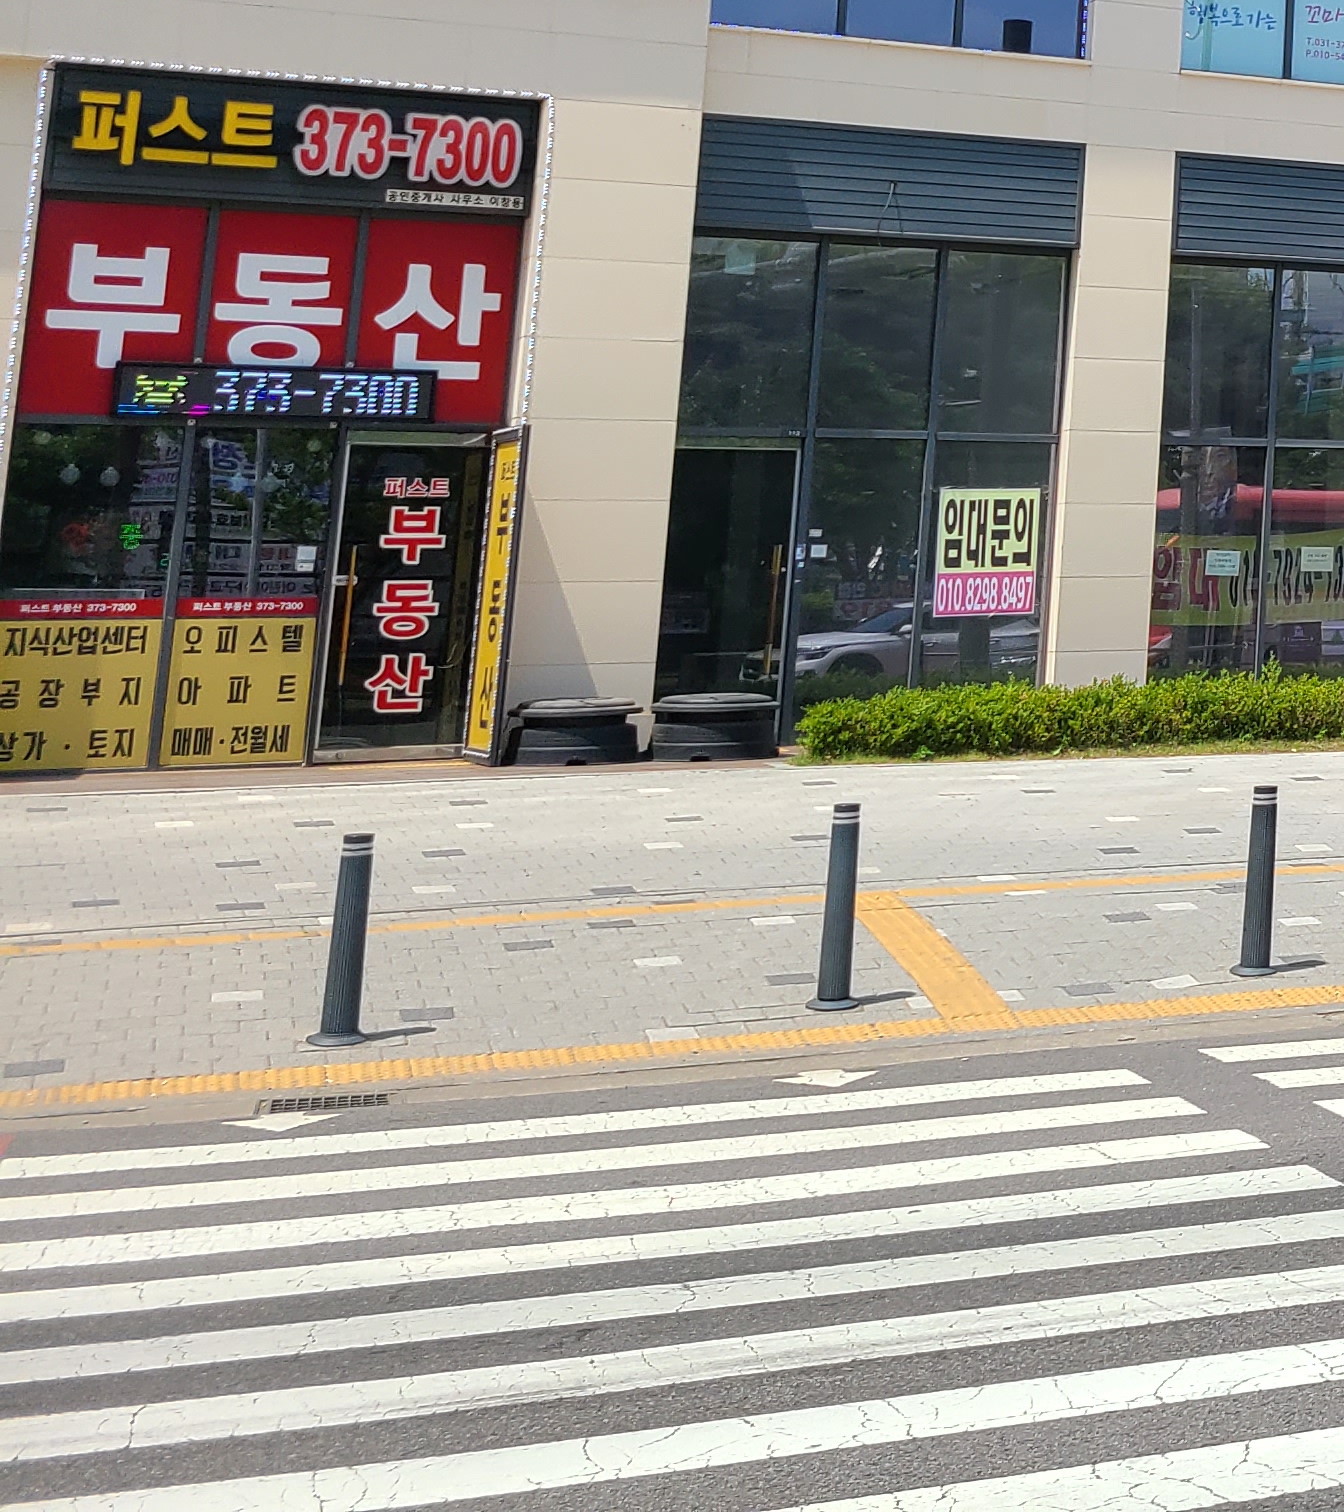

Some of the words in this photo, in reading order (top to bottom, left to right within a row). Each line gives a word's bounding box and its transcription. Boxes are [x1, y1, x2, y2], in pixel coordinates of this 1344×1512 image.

[72, 90, 277, 168] 퍼스트
[293, 105, 523, 187] 373-7300
[45, 242, 501, 382] 부동산
[384, 477, 450, 498] 퍼스트
[943, 498, 1035, 568] 임대문의
[20, 603, 50, 613] 퍼스트
[52, 602, 82, 613] 부동산
[86, 602, 136, 612] 373-7300
[193, 602, 221, 612] 퍼스트
[224, 601, 252, 612] 부동산
[256, 601, 303, 611] 373-7300
[364, 505, 447, 714] 부동산
[937, 576, 1034, 612] 010.8298.8497
[4, 625, 148, 657] 지식산업센터
[182, 624, 304, 655] 오피스텔
[178, 675, 296, 705] 아파트
[86, 728, 135, 758] 토지
